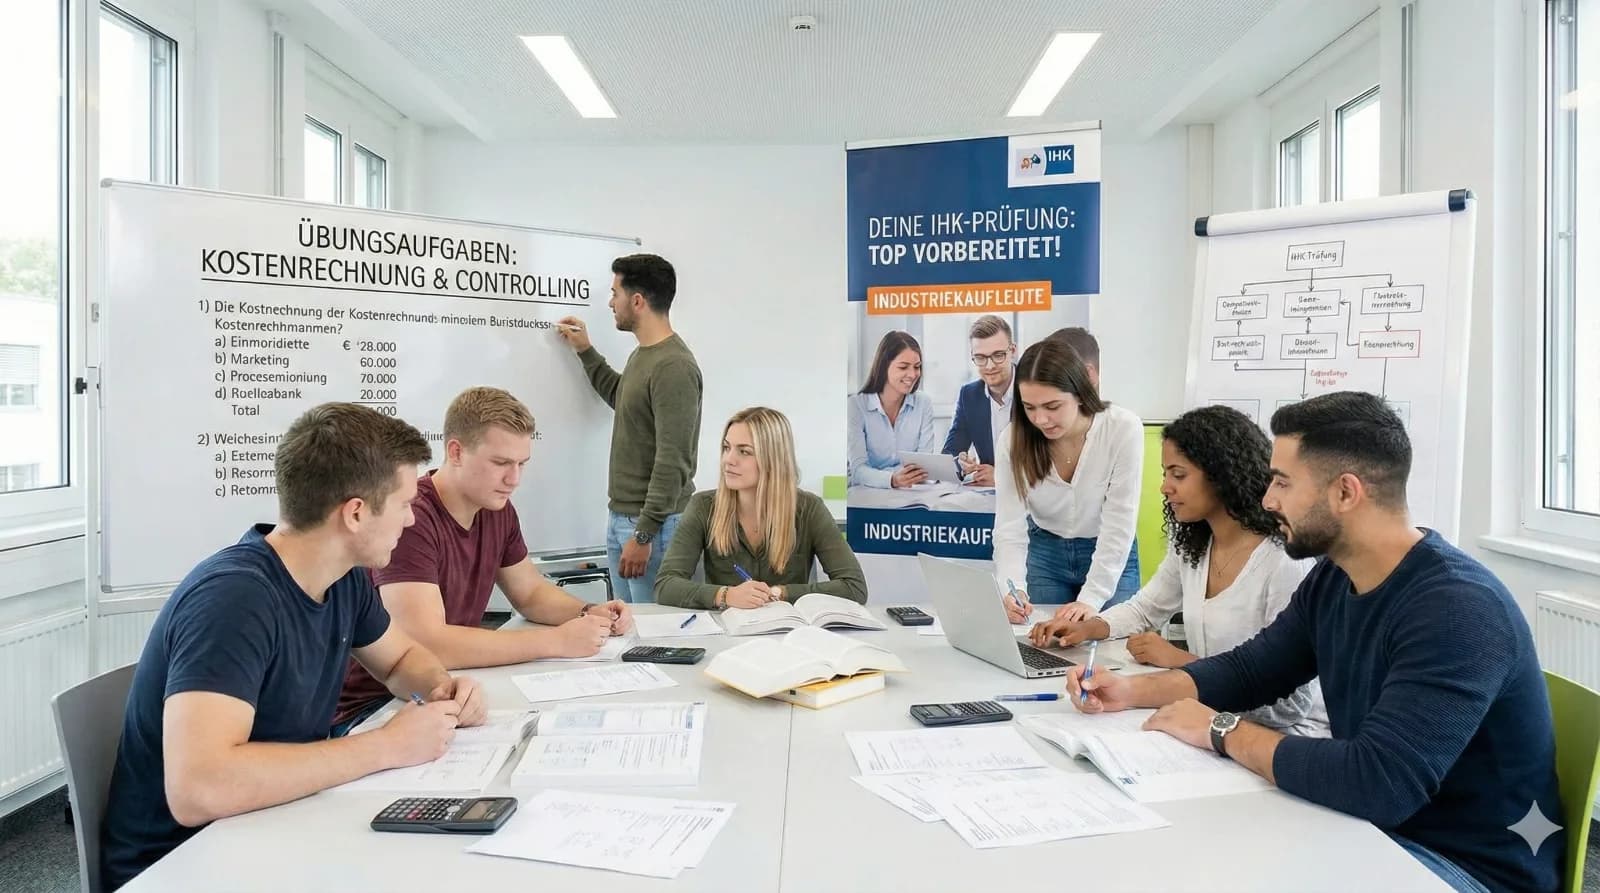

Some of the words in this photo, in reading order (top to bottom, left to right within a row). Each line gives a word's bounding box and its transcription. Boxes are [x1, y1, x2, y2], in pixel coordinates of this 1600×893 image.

[1048, 149, 1072, 162] IHK
[869, 215, 924, 239] DEINE
[931, 204, 1076, 236] IHK-PRÜFUNG:
[298, 218, 517, 266] ÜBUNGSAUFGABEN:
[868, 244, 906, 265] TOP
[912, 236, 1061, 264] VORBEREITET!
[202, 249, 426, 289] KOSTENRECHNUNG
[433, 268, 449, 290] &
[456, 269, 590, 300] CONTROLLING
[874, 288, 1045, 309] INDUSTRIEKAUFLEUTE
[198, 300, 210, 313] 1)
[215, 301, 235, 313] Die
[327, 307, 345, 319] der
[215, 336, 226, 349] a)
[343, 340, 351, 351] €
[215, 353, 227, 366] b)
[231, 354, 290, 368] Marketing
[360, 357, 397, 368] 60.000
[215, 370, 226, 384] c)
[360, 373, 397, 384] 70.000
[215, 387, 227, 400] d)
[360, 389, 397, 400] 20.000
[232, 404, 260, 416] Total
[197, 433, 210, 446] 2)
[215, 450, 227, 463] a)
[215, 467, 227, 480] b)
[215, 484, 226, 497] c)
[864, 522, 993, 545] INDUSTRIEKAUF
